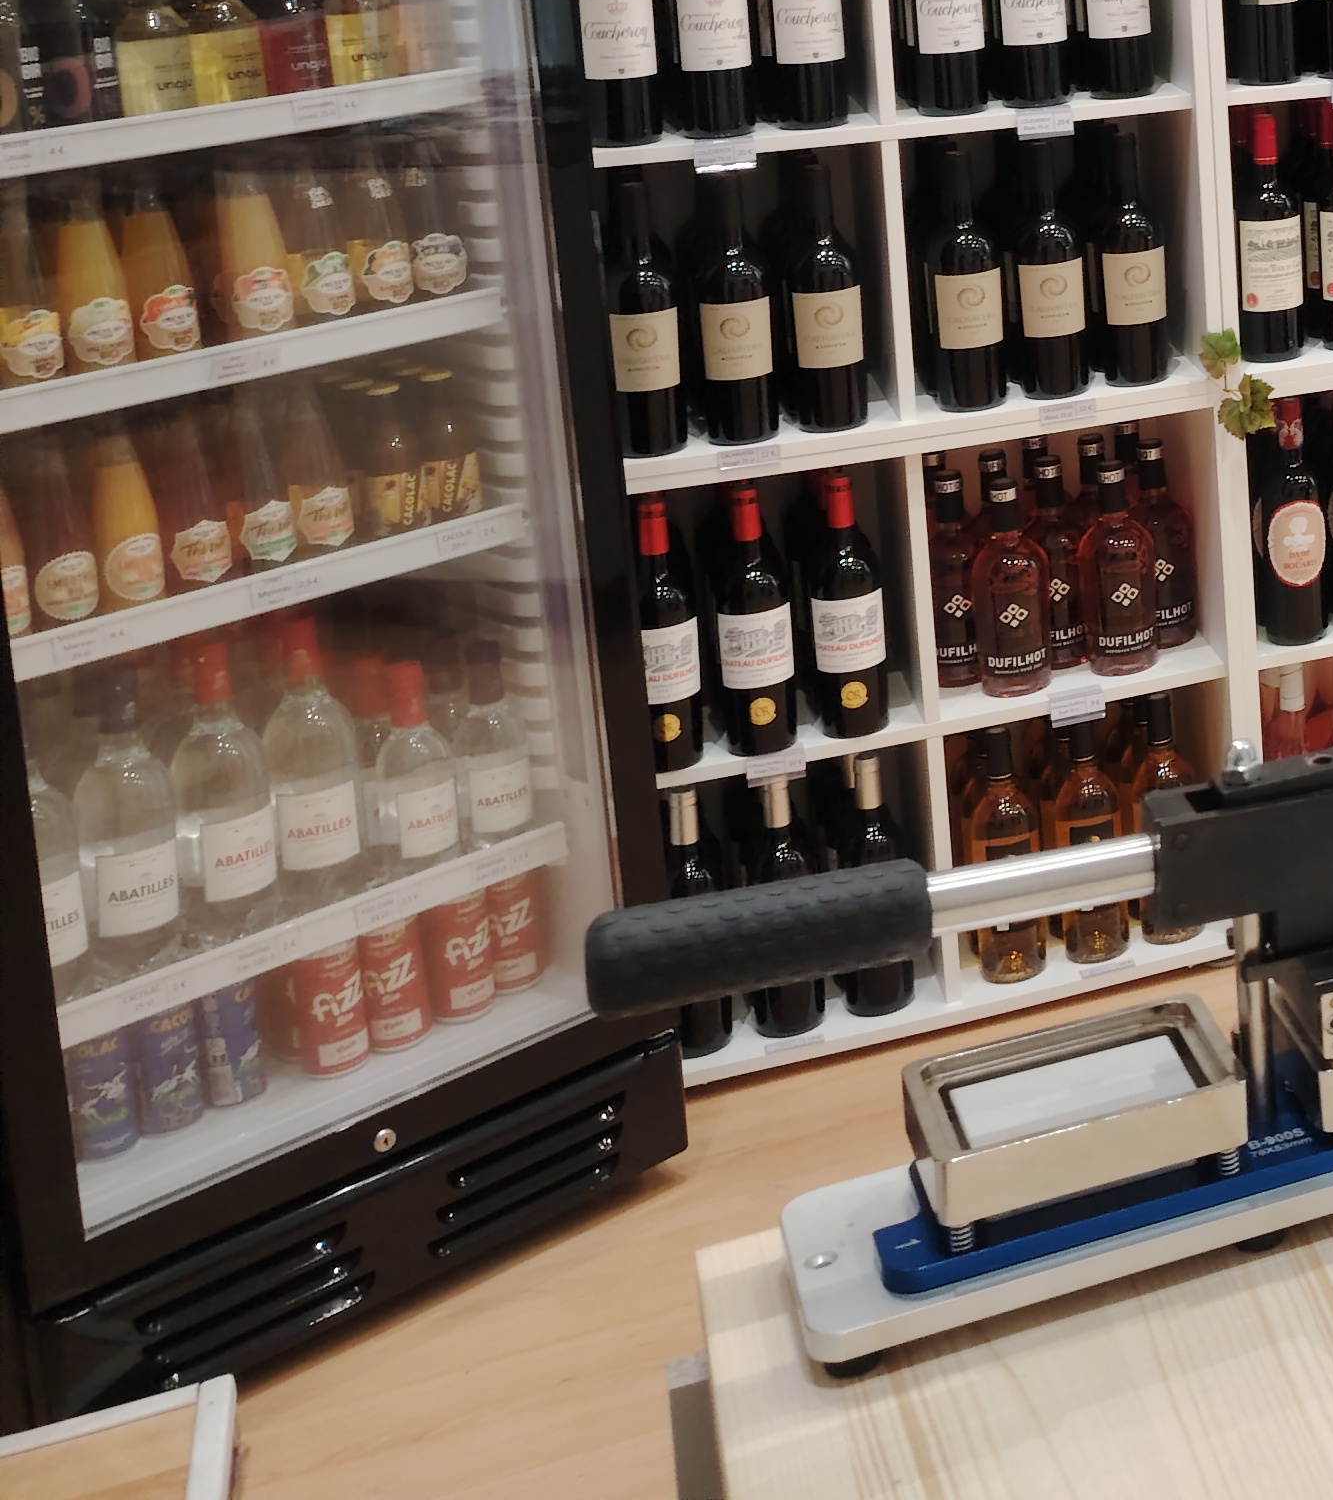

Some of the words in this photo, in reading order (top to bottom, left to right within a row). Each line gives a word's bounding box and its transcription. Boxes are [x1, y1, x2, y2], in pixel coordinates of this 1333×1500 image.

[680, 11, 746, 34] Coucheroy
[776, 5, 839, 29] Coucheroy
[583, 19, 649, 43] Coucheroy
[442, 457, 459, 513] CACOLAC
[402, 472, 418, 528] CACOLAC
[849, 633, 883, 652] DUFILHOT
[1099, 627, 1154, 648] DUFILHOT
[756, 649, 792, 667] DUFILHOT
[988, 648, 1047, 668] DUFILHOT
[477, 785, 528, 808] ABATILLES
[287, 815, 352, 840] ABATILLES
[407, 808, 456, 832] ABATILLES
[214, 841, 273, 870] ABATILLES
[108, 874, 175, 904] ABATILLES
[1247, 1127, 1305, 1150] B-900S
